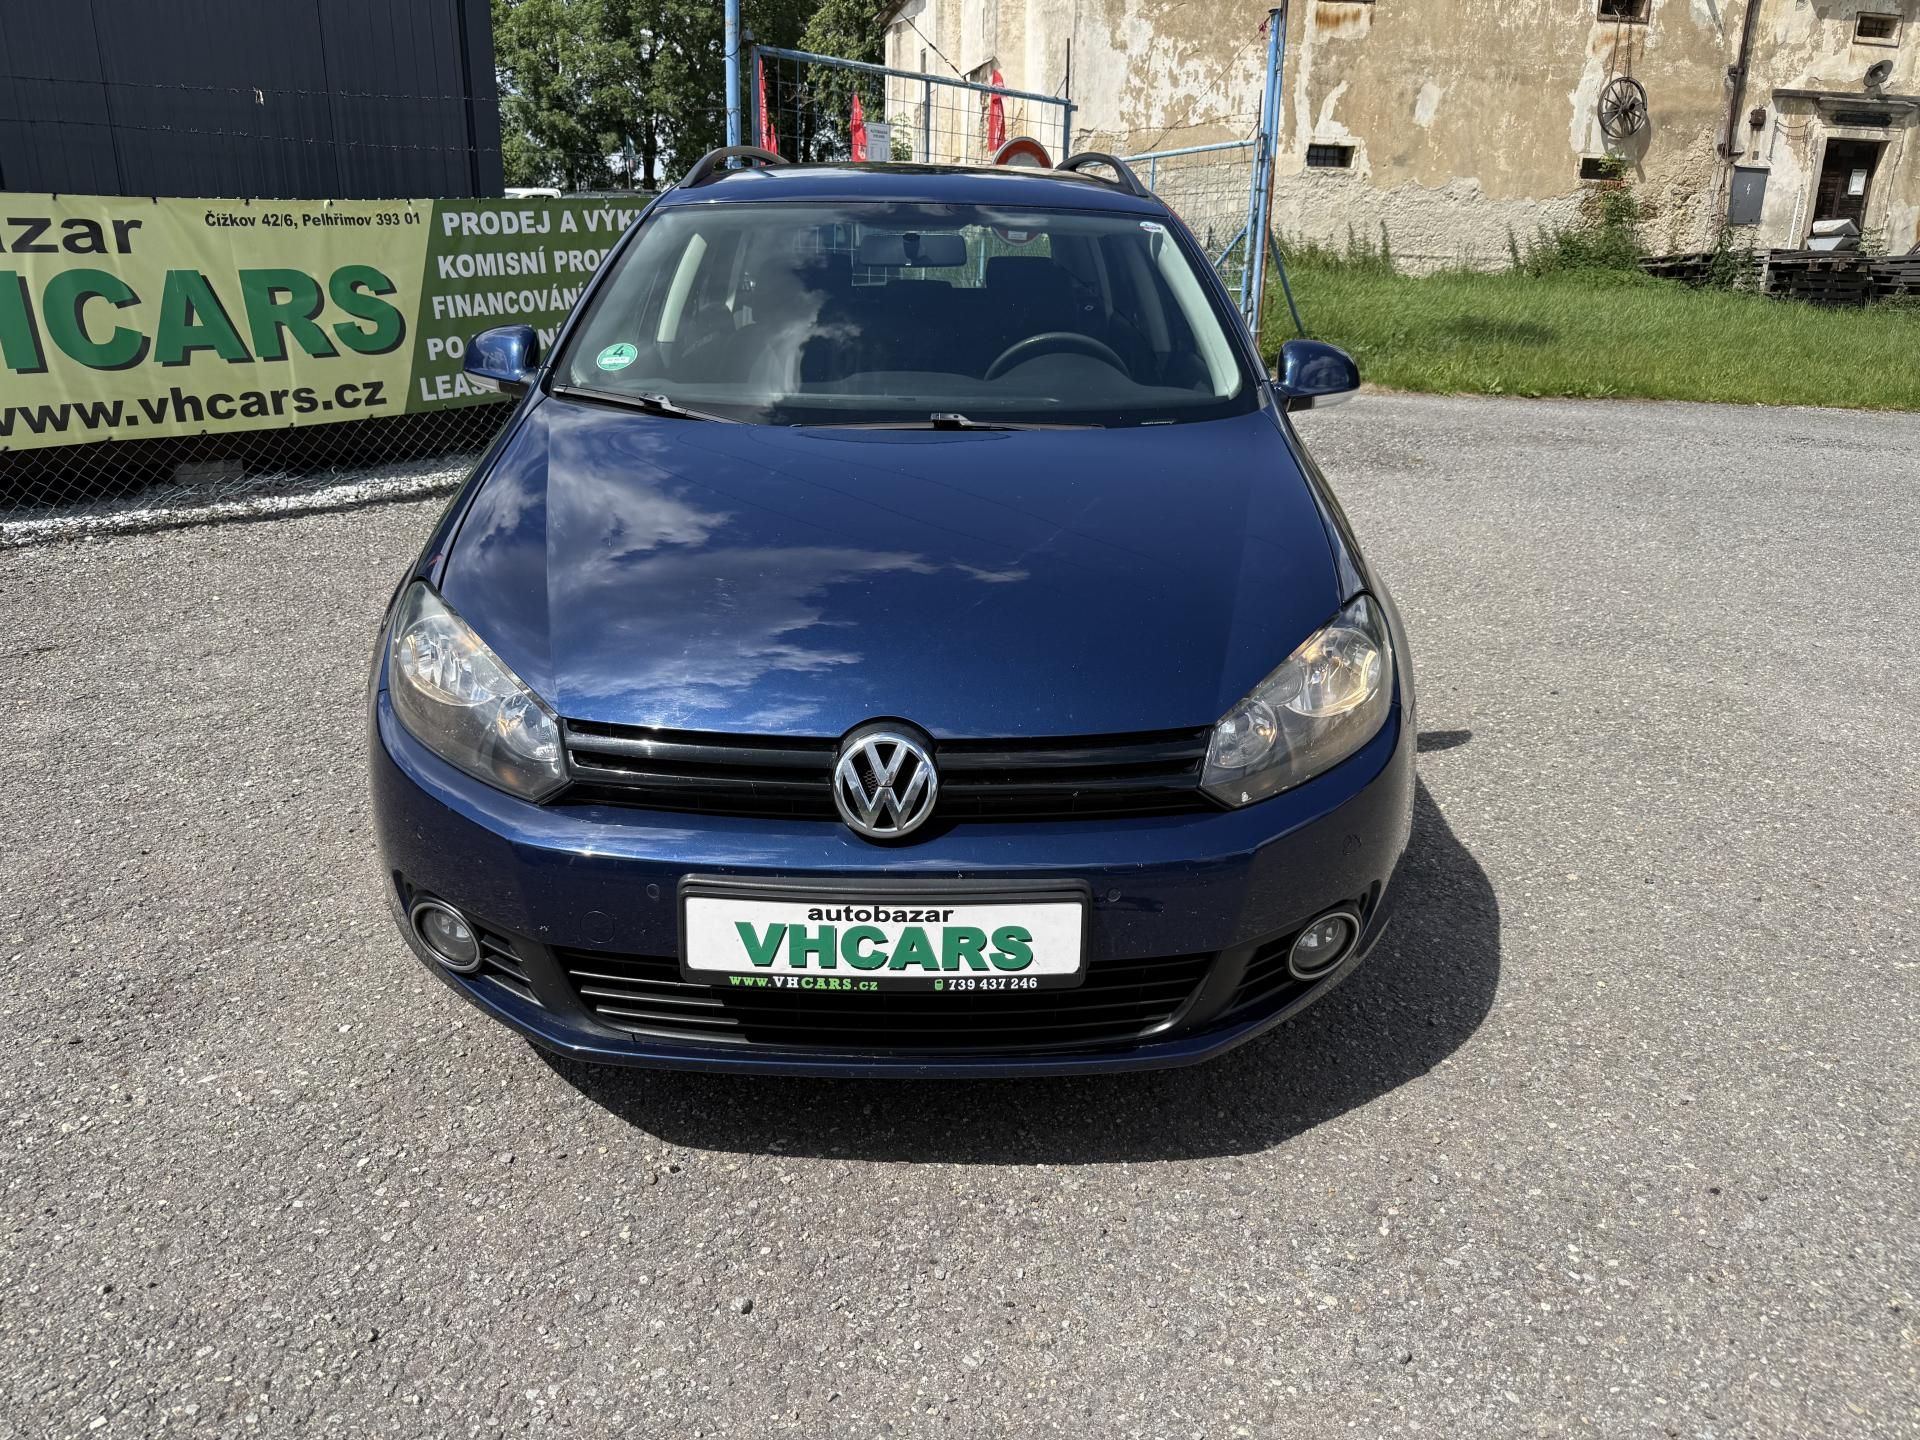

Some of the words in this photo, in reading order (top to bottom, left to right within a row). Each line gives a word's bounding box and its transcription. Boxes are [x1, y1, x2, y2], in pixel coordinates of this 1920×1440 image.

[205, 210, 256, 227] Čížkov
[262, 213, 298, 229] 42/6,
[302, 212, 371, 227] Pelhřimov
[376, 212, 400, 226] 393
[404, 212, 421, 225] 01
[442, 210, 551, 236] PRODEJ
[560, 210, 578, 233] A
[583, 203, 641, 232] VÝK
[0, 217, 142, 254] zar
[437, 246, 547, 279] KOMISNÍ
[613, 345, 624, 357] 4
[837, 734, 935, 836] VW
[807, 906, 954, 924] autobazar
[734, 921, 1034, 972] VHCARS
[729, 976, 879, 991] www.VHCARS.cz
[948, 978, 975, 991] 739
[979, 978, 1006, 991] 437
[1010, 977, 1038, 991] 246
